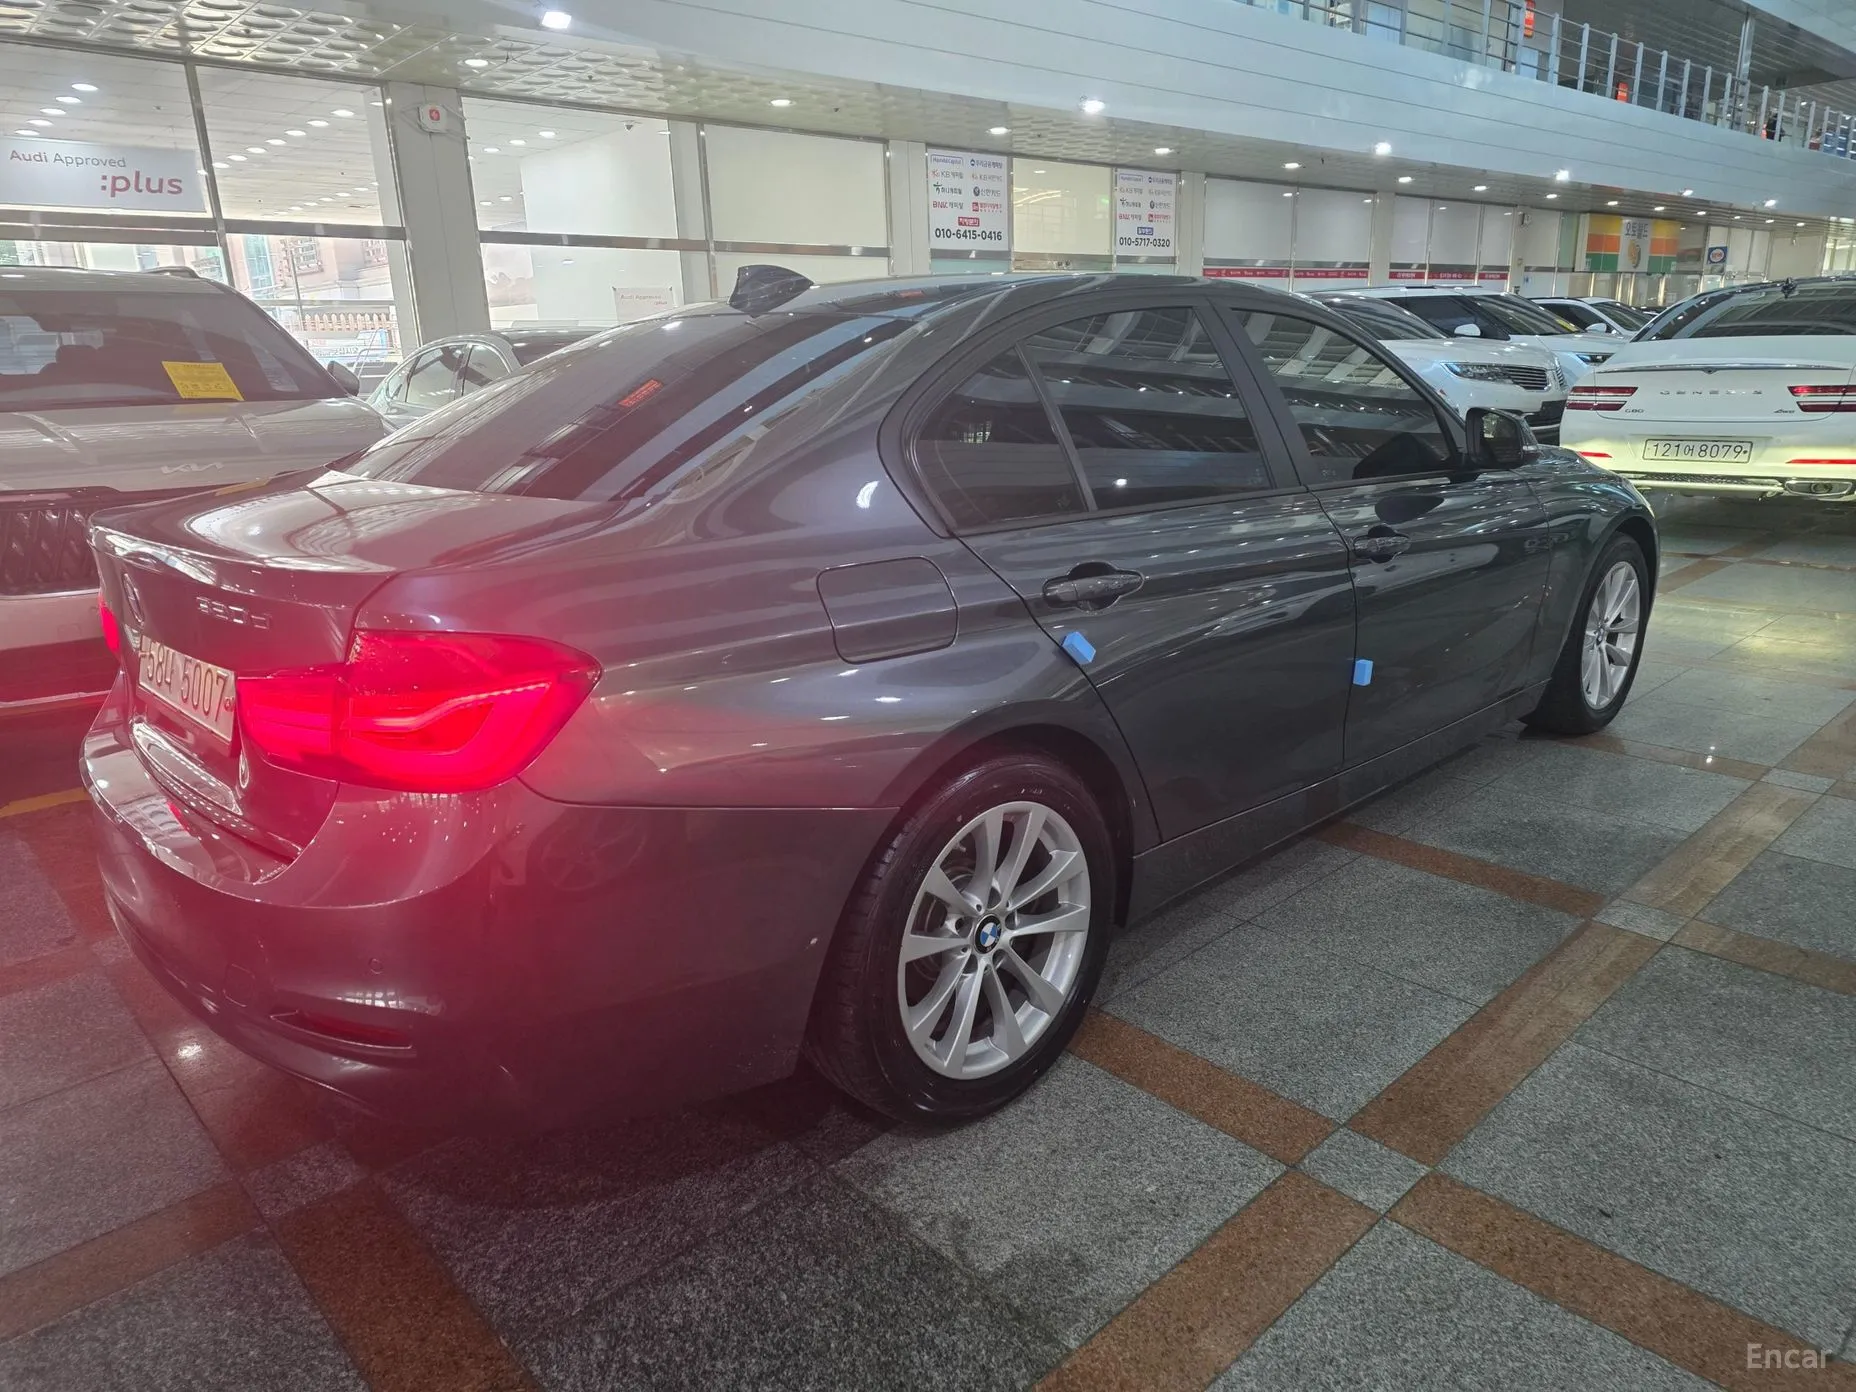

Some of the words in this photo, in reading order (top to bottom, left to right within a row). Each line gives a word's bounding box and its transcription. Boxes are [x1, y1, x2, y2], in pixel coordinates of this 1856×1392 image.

[10, 150, 48, 163] Audi
[53, 153, 127, 168] Approved
[101, 170, 183, 198] :plus
[935, 228, 1002, 240] 010-6415-0416
[1119, 237, 1170, 247] 010-5717-0320
